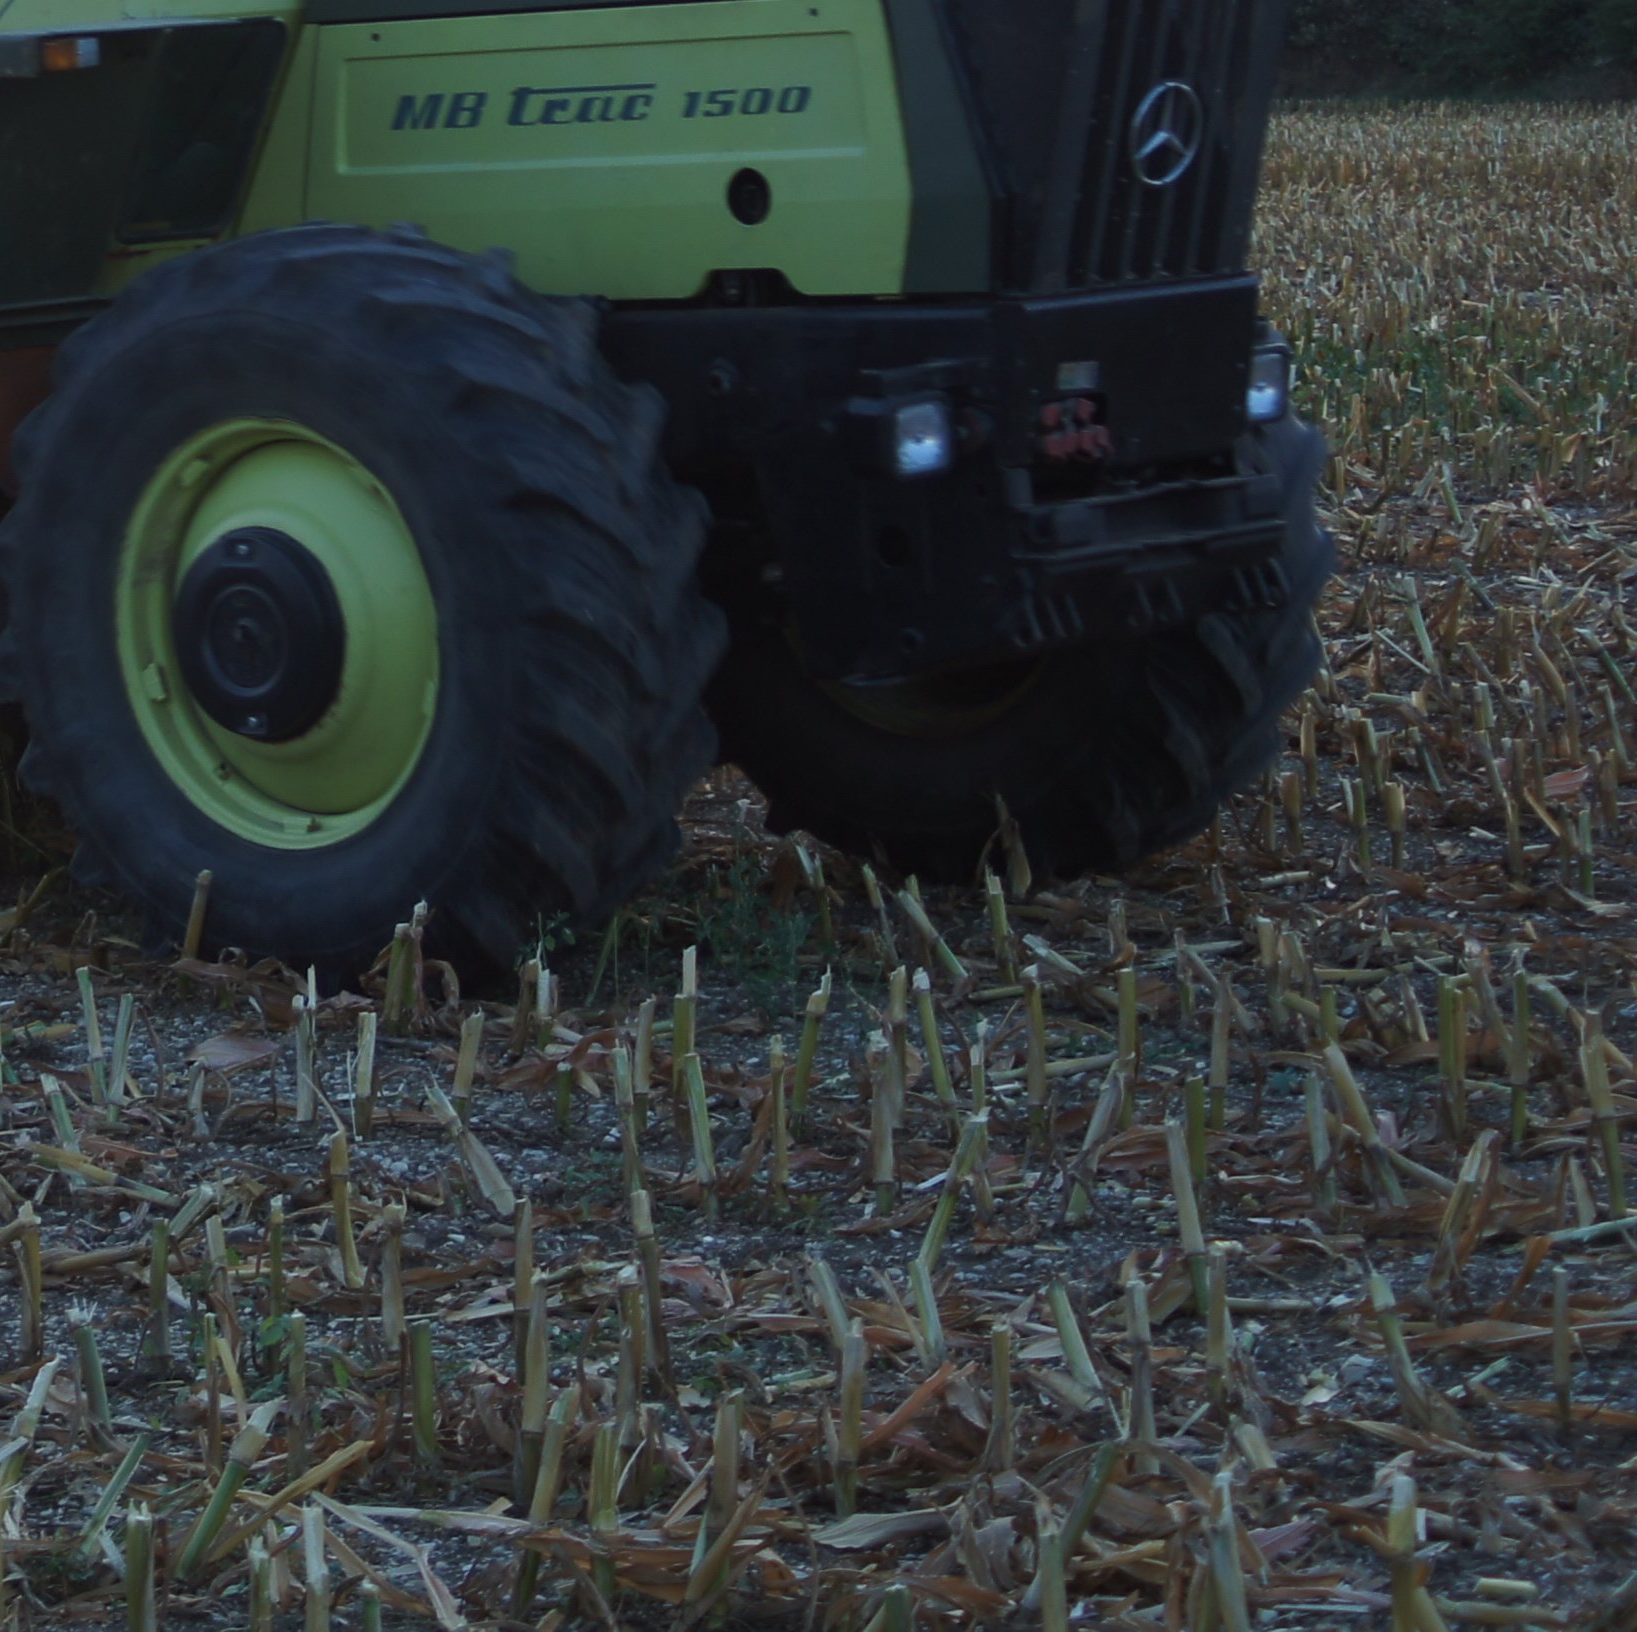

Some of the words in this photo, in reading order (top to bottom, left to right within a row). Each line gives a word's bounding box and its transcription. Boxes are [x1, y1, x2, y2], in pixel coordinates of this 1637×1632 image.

[390, 92, 488, 131] MB
[506, 83, 657, 127] trac
[682, 86, 813, 119] 1500
